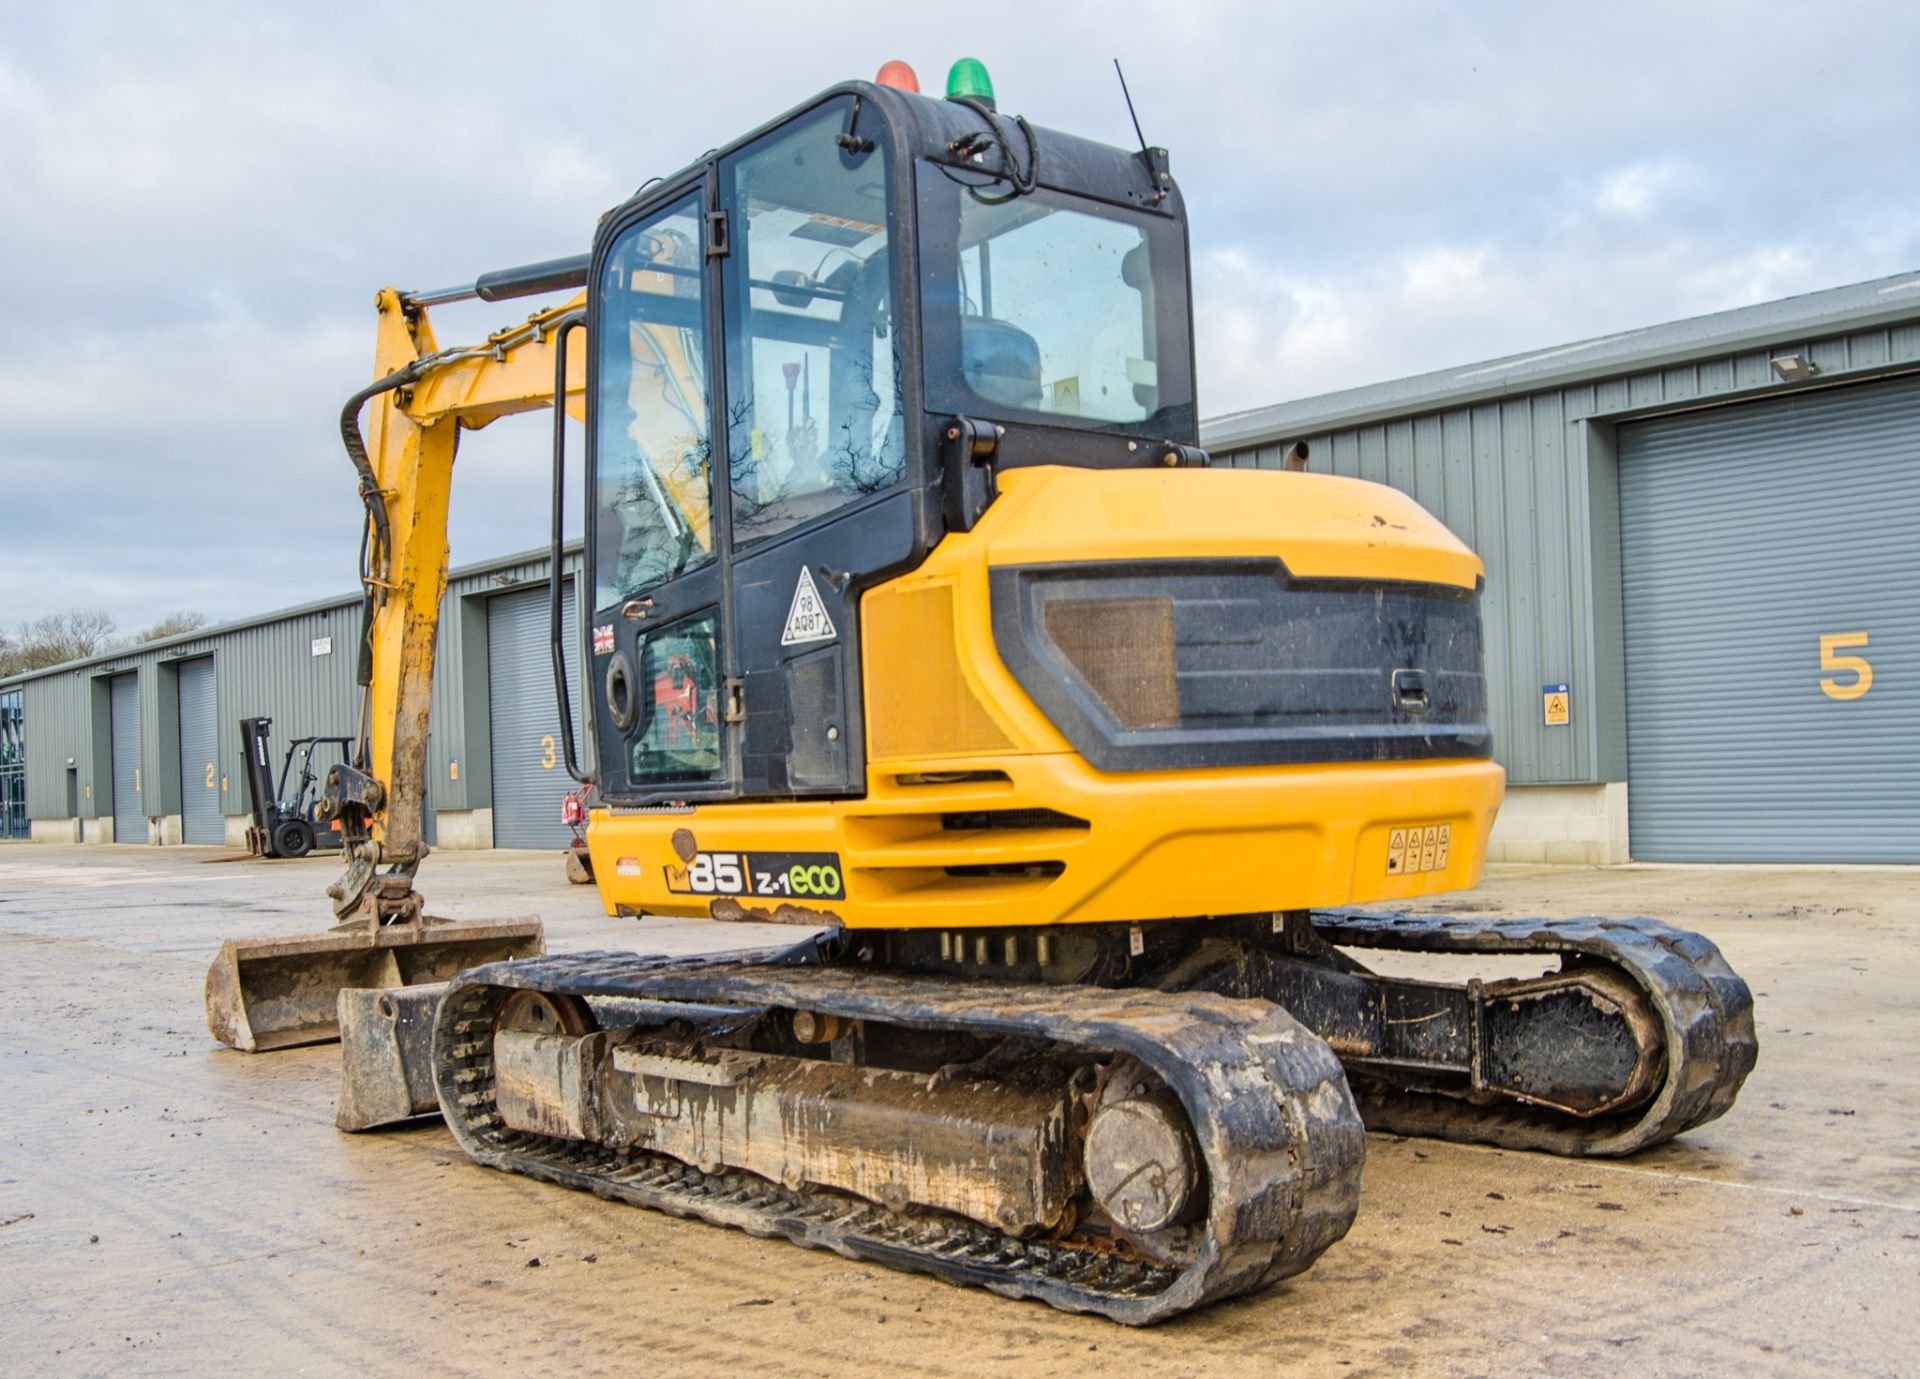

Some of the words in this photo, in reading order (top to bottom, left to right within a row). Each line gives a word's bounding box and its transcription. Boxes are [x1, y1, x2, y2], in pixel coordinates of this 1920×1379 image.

[800, 595, 813, 613] 98
[1819, 631, 1873, 701] 5
[541, 735, 556, 769] 3
[135, 768, 141, 791] 1
[205, 762, 215, 788] 2
[687, 853, 743, 893] 85
